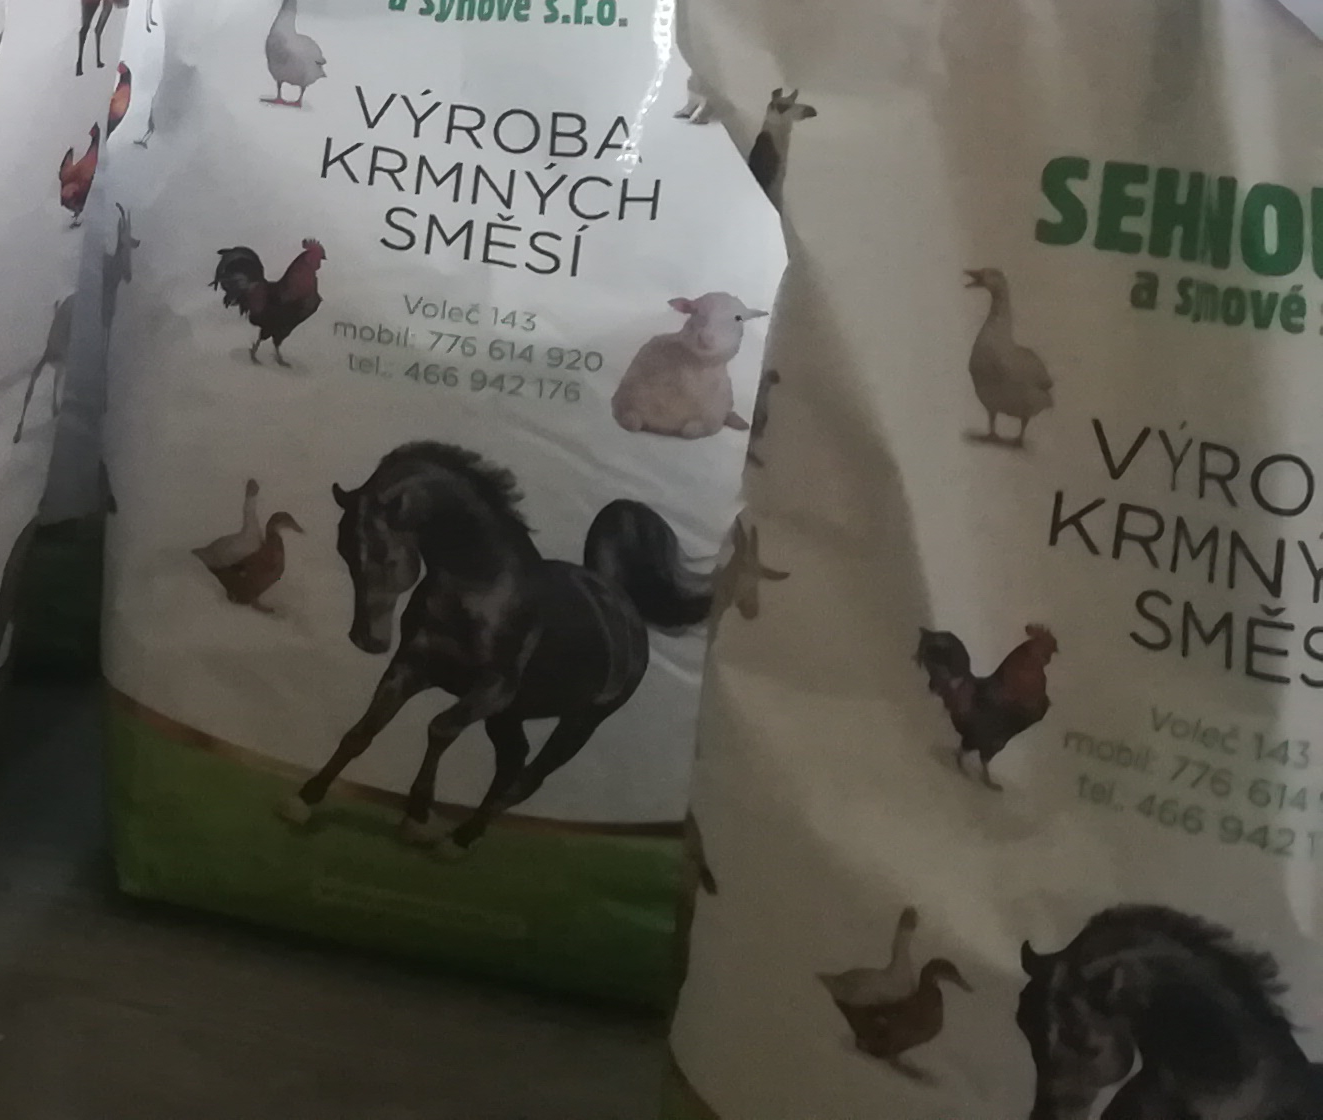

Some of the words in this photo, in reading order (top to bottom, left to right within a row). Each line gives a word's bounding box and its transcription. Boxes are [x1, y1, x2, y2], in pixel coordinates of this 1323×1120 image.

[354, 85, 643, 164] VÝROBA
[320, 136, 662, 223] KRMNÝCH
[379, 206, 590, 278] SMĚSÍ
[1034, 155, 1323, 280] SEHNO
[403, 294, 481, 326] Voleč
[492, 306, 537, 332] 143
[1130, 271, 1159, 310] a
[428, 330, 478, 358] 776
[488, 338, 535, 364] 614
[546, 346, 604, 373] 920
[404, 361, 459, 387] 466
[470, 368, 526, 399] 942
[536, 378, 581, 403] 176
[1255, 731, 1311, 769] 143
[1170, 754, 1234, 798] 776
[1248, 779, 1308, 812] 614
[1136, 793, 1205, 835] 466
[1219, 814, 1296, 857] 942
